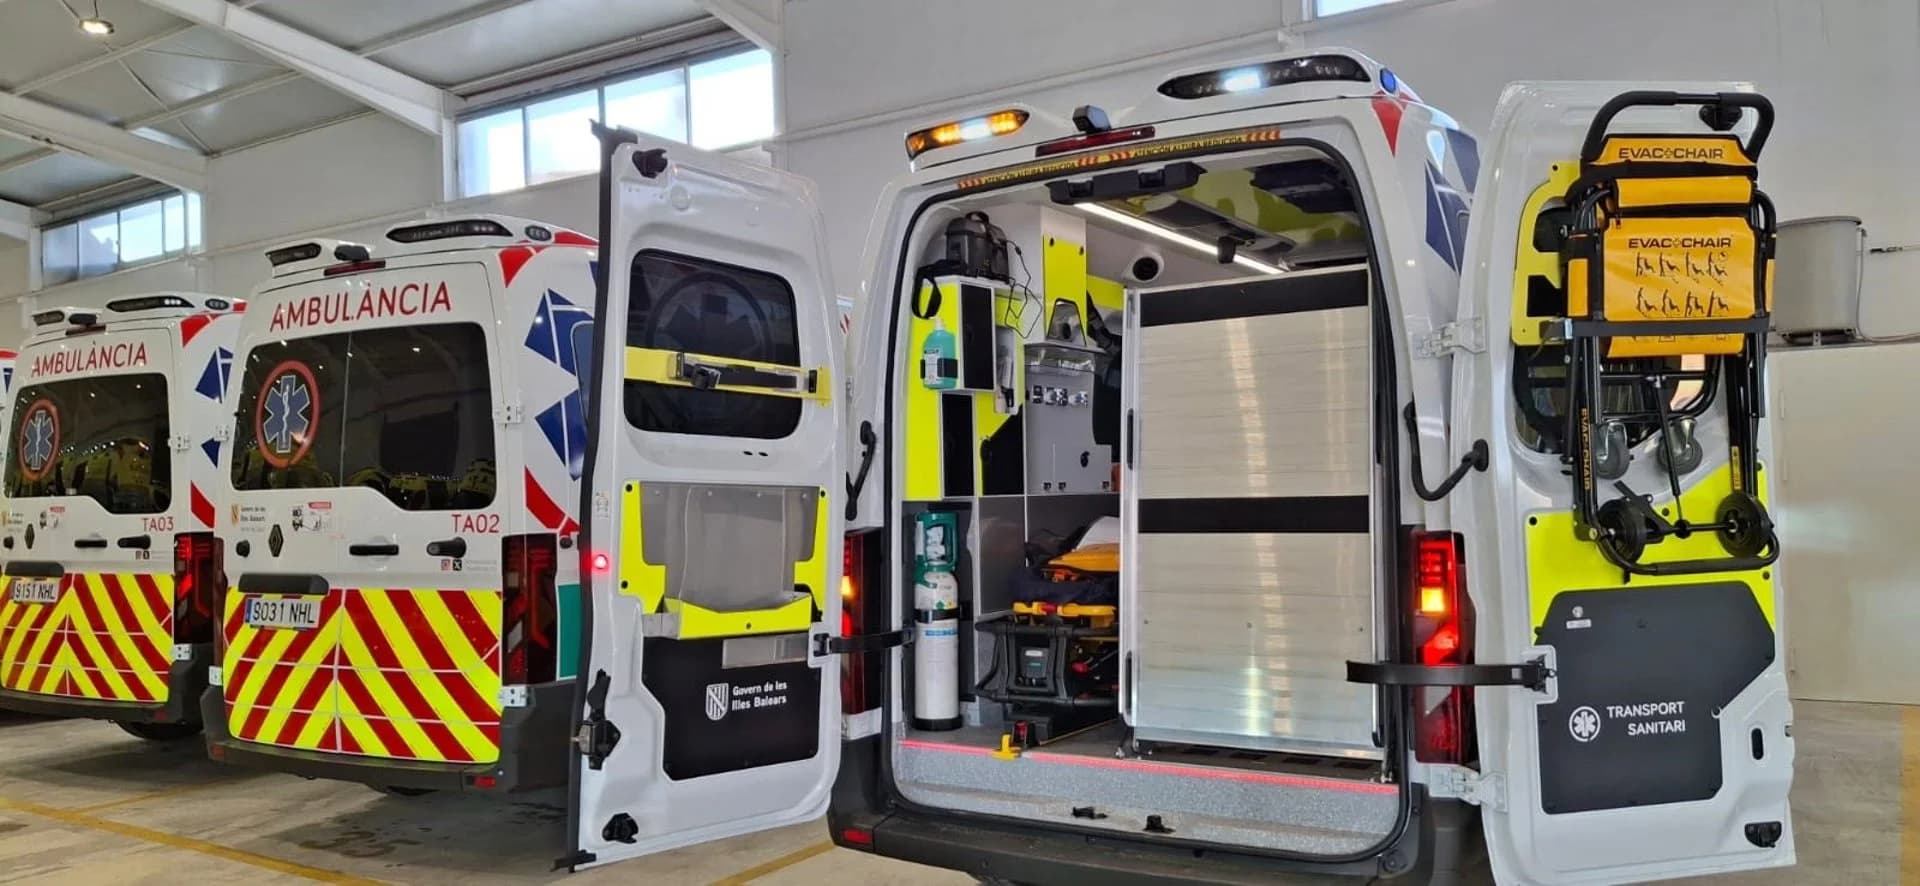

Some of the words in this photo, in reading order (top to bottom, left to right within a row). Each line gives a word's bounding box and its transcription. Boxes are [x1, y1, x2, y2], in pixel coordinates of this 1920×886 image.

[269, 281, 452, 332] AMBULÀNCIA
[31, 341, 148, 378] AMBULÀNCIA
[142, 517, 174, 532] TA03
[451, 513, 500, 533] TA02
[37, 585, 56, 600] NHL
[289, 602, 315, 624] NHL
[732, 685, 762, 696] Govern
[764, 681, 774, 692] de
[732, 699, 751, 711] Illes
[754, 695, 787, 707] Balears
[1606, 700, 1685, 719] TRANSPORT
[1627, 719, 1686, 736] SANITARI
